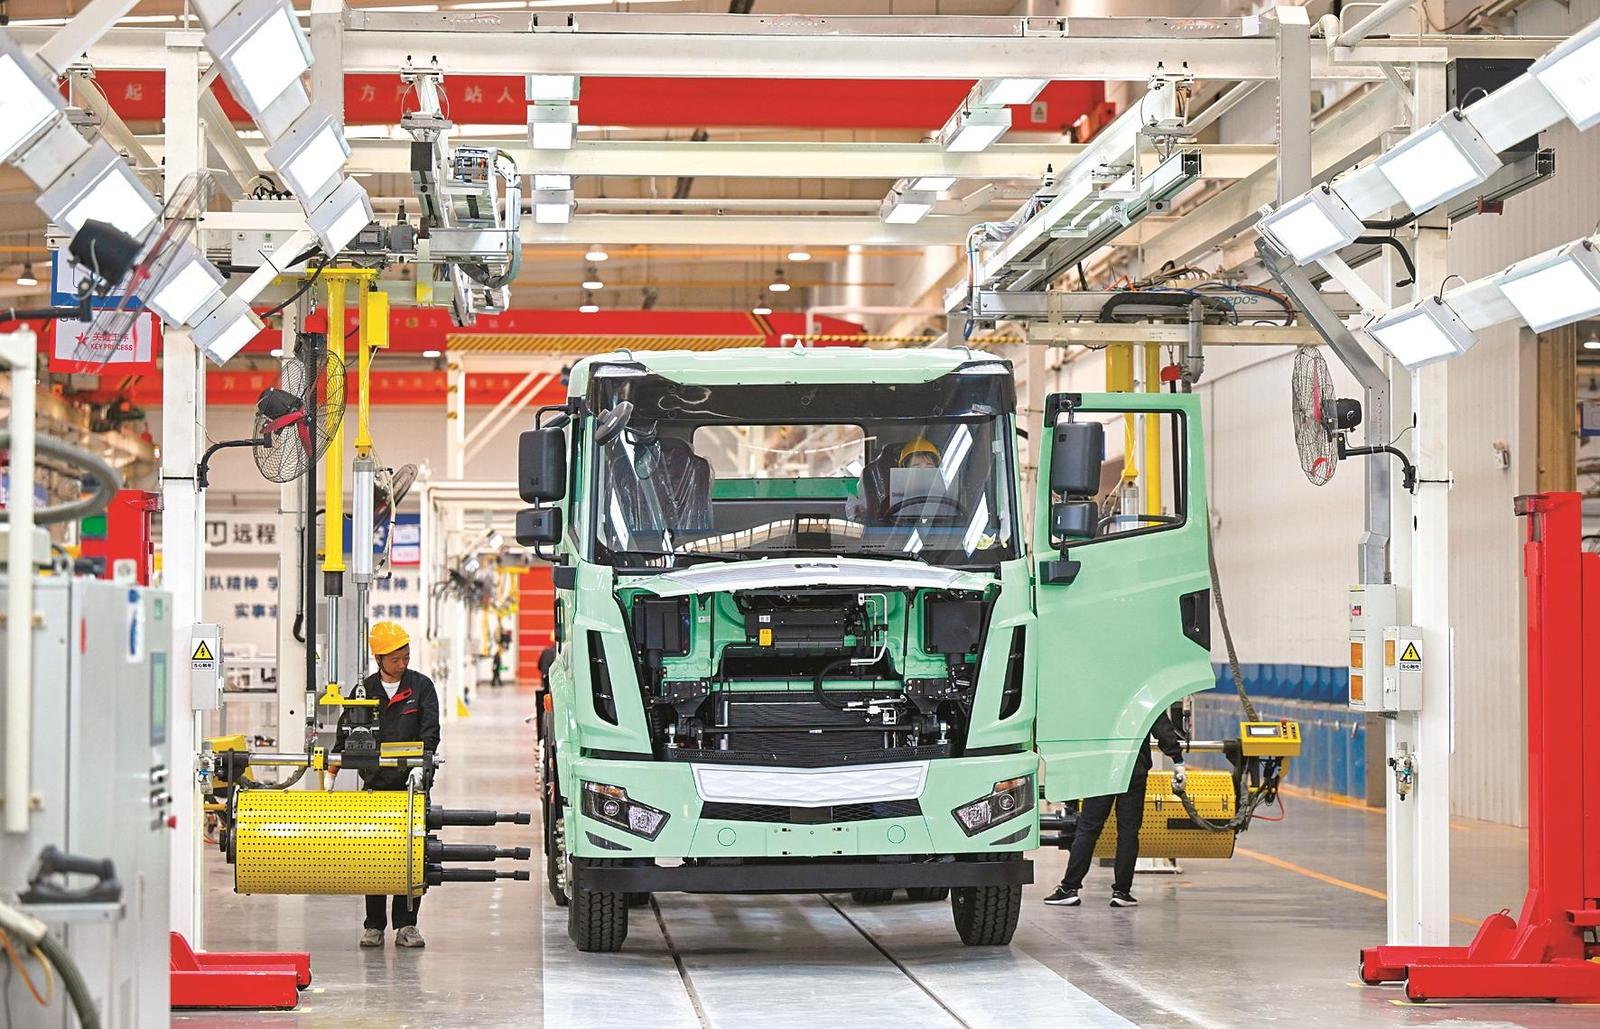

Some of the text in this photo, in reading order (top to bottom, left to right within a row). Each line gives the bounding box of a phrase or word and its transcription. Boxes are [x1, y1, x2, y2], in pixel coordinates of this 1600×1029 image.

[233, 523, 276, 544] 远程
[205, 575, 258, 592] 队精神
